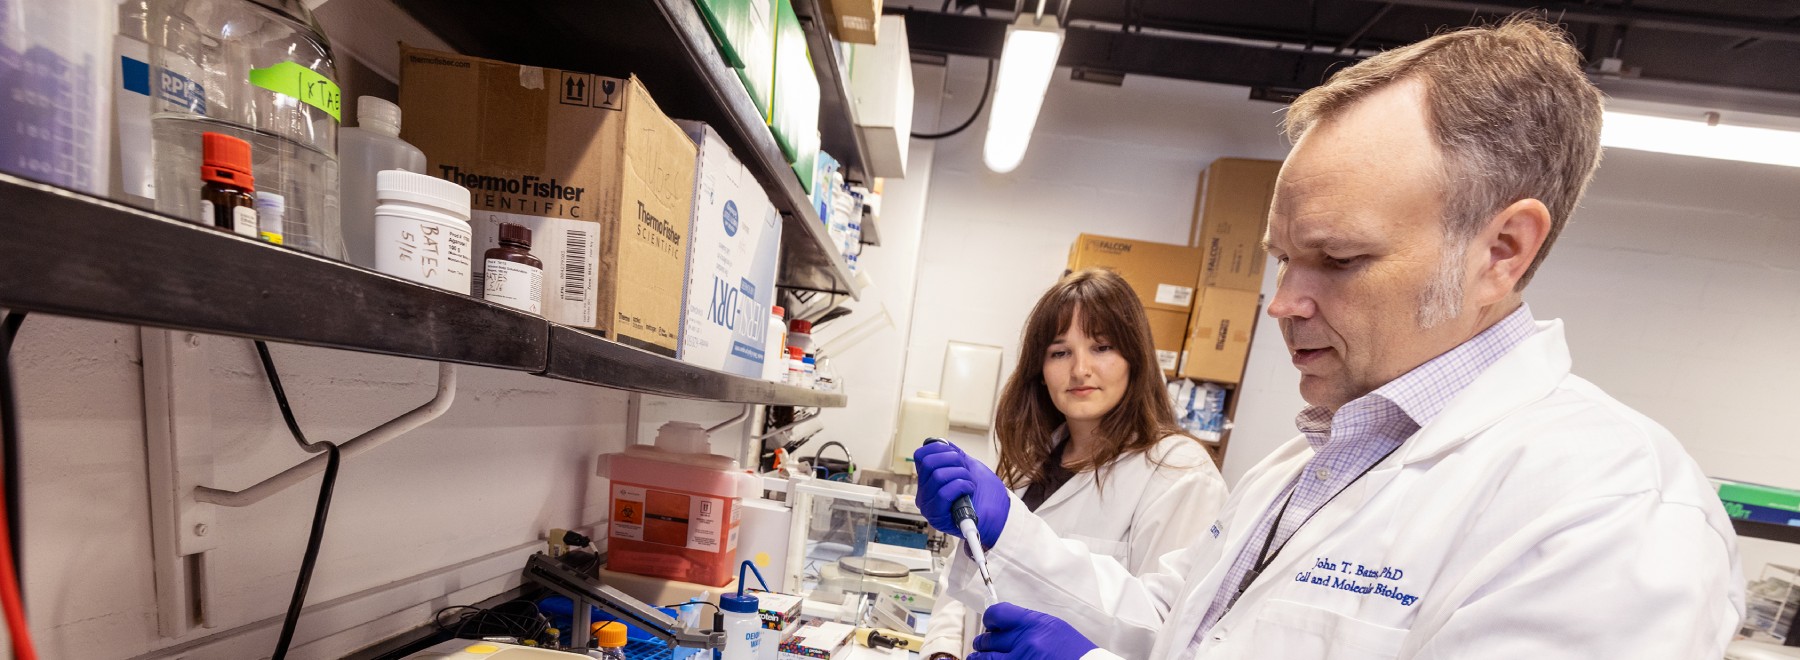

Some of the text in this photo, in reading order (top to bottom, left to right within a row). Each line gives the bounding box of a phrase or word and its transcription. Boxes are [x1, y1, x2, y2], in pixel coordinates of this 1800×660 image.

[475, 193, 580, 218] IENTIFIC
[420, 223, 440, 279] BATES
[636, 223, 679, 260] SCIENTIFIC
[1100, 241, 1132, 252] FALCON
[1207, 237, 1220, 272] FALCON
[1312, 557, 1337, 571] John
[1380, 566, 1403, 581] PhD
[1311, 575, 1331, 587] and
[1373, 583, 1418, 606] Biology
